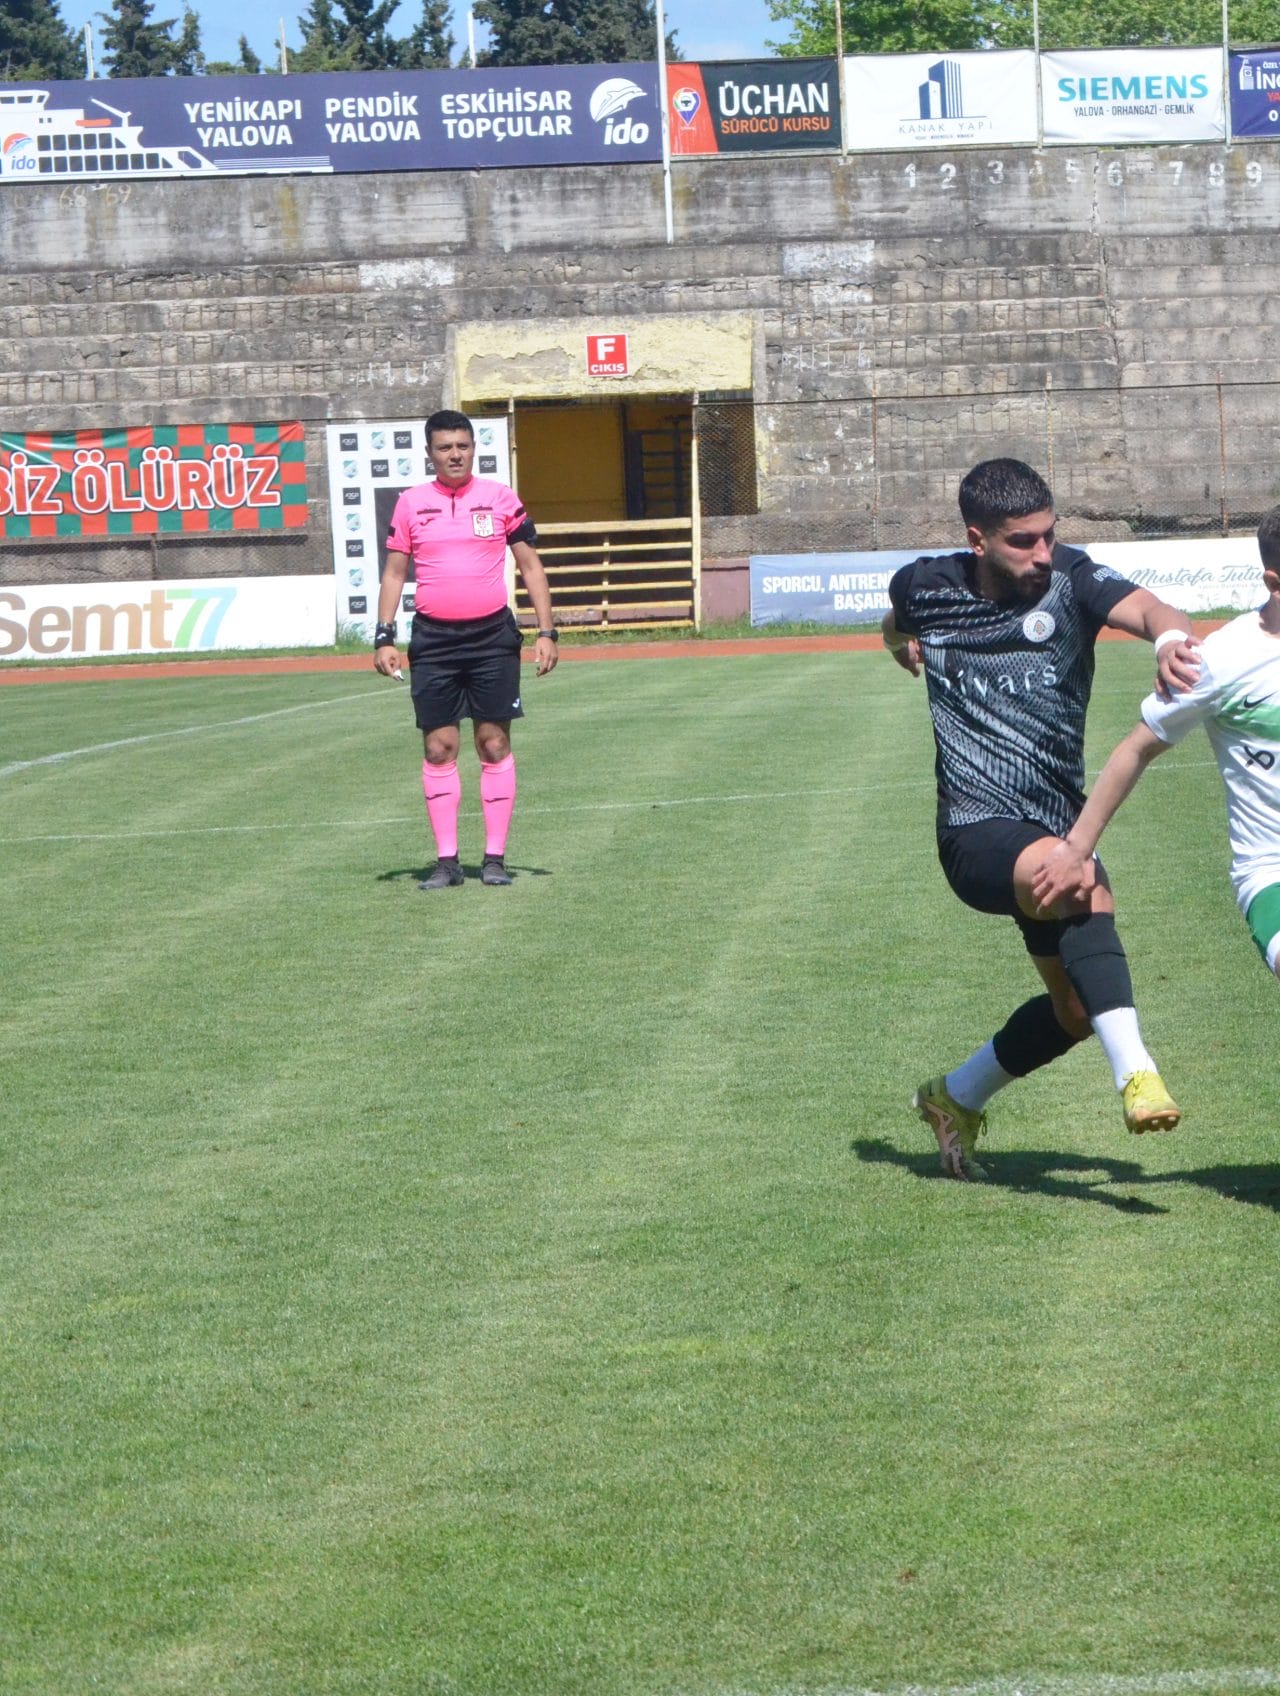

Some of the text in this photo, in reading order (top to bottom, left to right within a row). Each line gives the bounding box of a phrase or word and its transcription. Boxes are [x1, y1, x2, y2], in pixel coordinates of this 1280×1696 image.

[1262, 61, 1278, 69] ÖZEL
[1058, 74, 1209, 102] SIEMENS
[184, 96, 302, 123] YENİKAPI
[326, 91, 418, 118] PENDİK
[441, 87, 572, 114] ESKİHİSAR
[1074, 106, 1105, 117] YALOVA
[1111, 103, 1158, 116] ORHANGAZİ
[1164, 102, 1195, 115] GEMLİK
[721, 116, 830, 134] SÜRÜCÜ KURSU
[899, 121, 992, 134] KANAK YAPI
[1268, 110, 1279, 122] 0
[197, 124, 293, 147] YALOVA
[326, 120, 421, 143] YALOVA
[443, 115, 572, 142] TOPÇULAR
[604, 117, 649, 145] ido
[11, 155, 36, 170] ido
[904, 163, 917, 188] 1
[939, 162, 957, 189] 2
[987, 160, 1004, 185] 3
[1107, 161, 1124, 187] 6
[1168, 160, 1184, 186] 7
[1246, 161, 1262, 188] 9
[596, 338, 616, 361] F
[591, 363, 625, 374] ÇIKIŞ
[71, 444, 282, 513] ÖLÜRÜZ
[763, 574, 825, 595] SPORCU,
